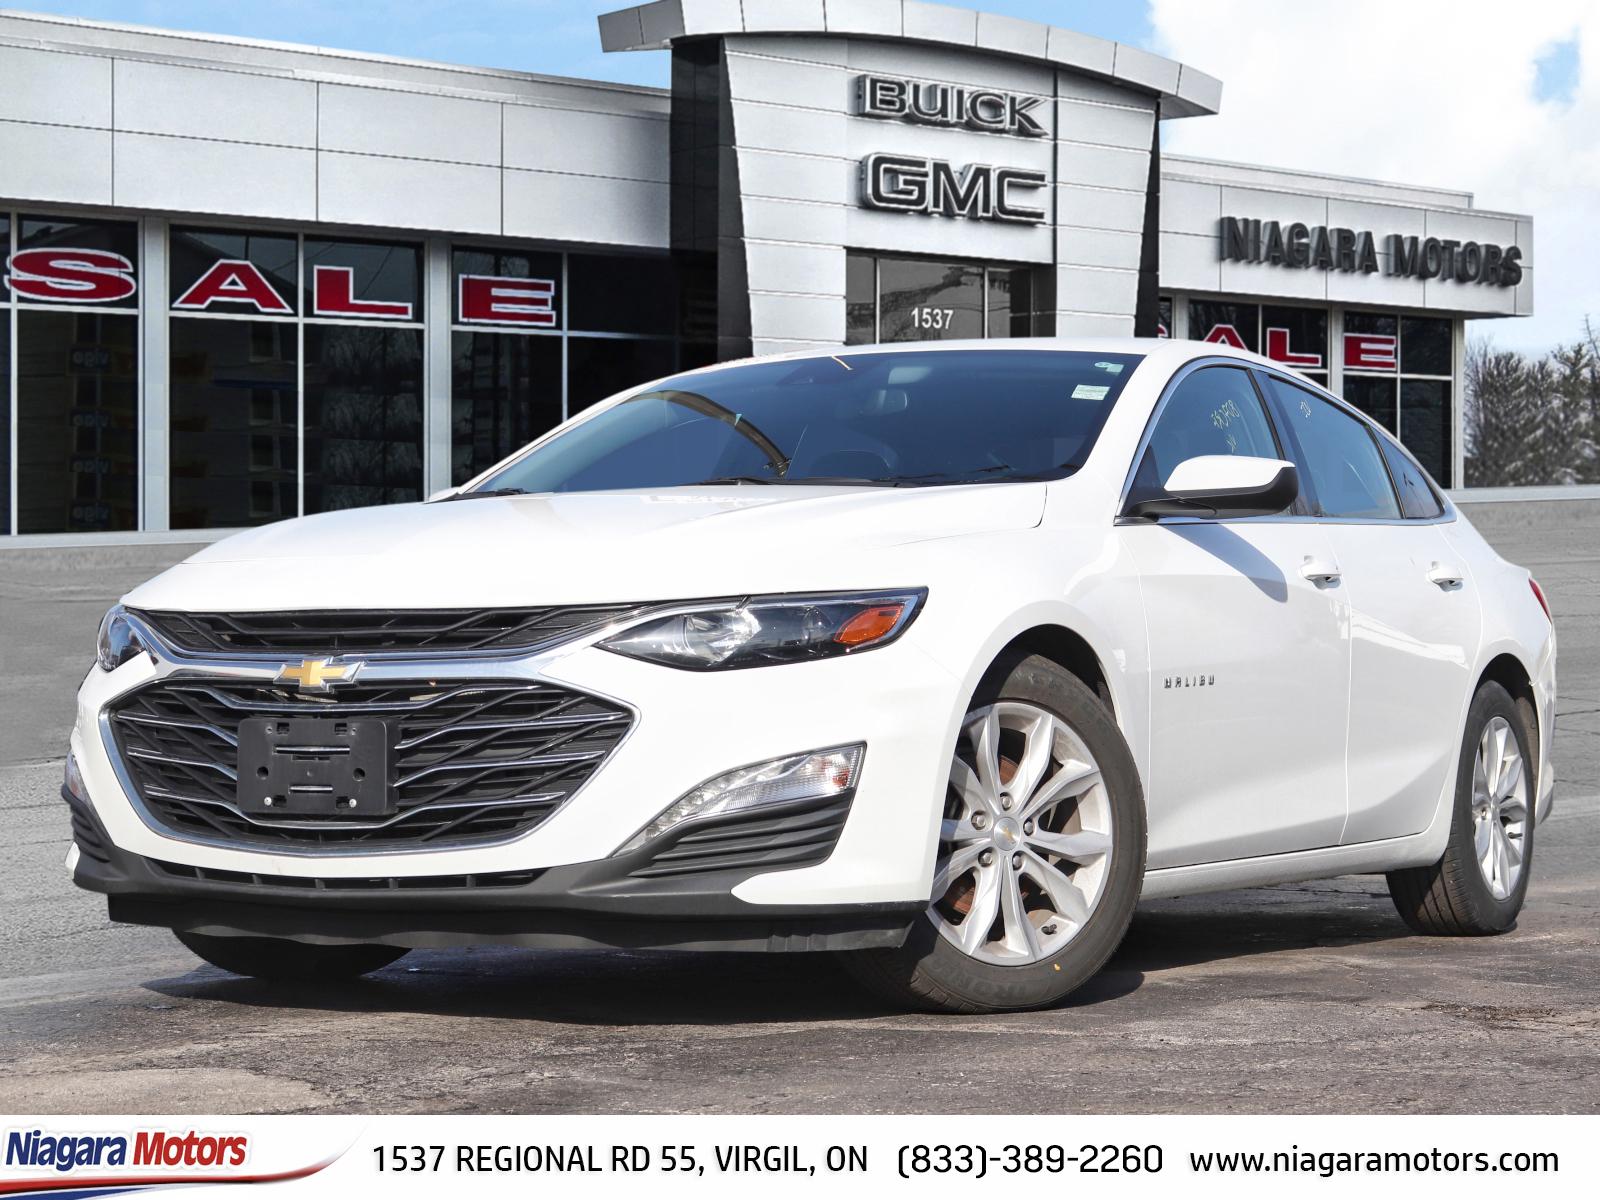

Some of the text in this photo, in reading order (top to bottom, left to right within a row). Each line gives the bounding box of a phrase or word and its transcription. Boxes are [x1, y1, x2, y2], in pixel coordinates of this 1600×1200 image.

[857, 74, 1048, 137] BUICK
[861, 152, 1047, 226] GMC
[1220, 216, 1523, 287] NIAGARA MOTORS
[4, 246, 556, 327] SALE
[910, 307, 954, 330] 1537
[1158, 323, 1397, 371] ALE
[1163, 674, 1215, 689] MALIBU
